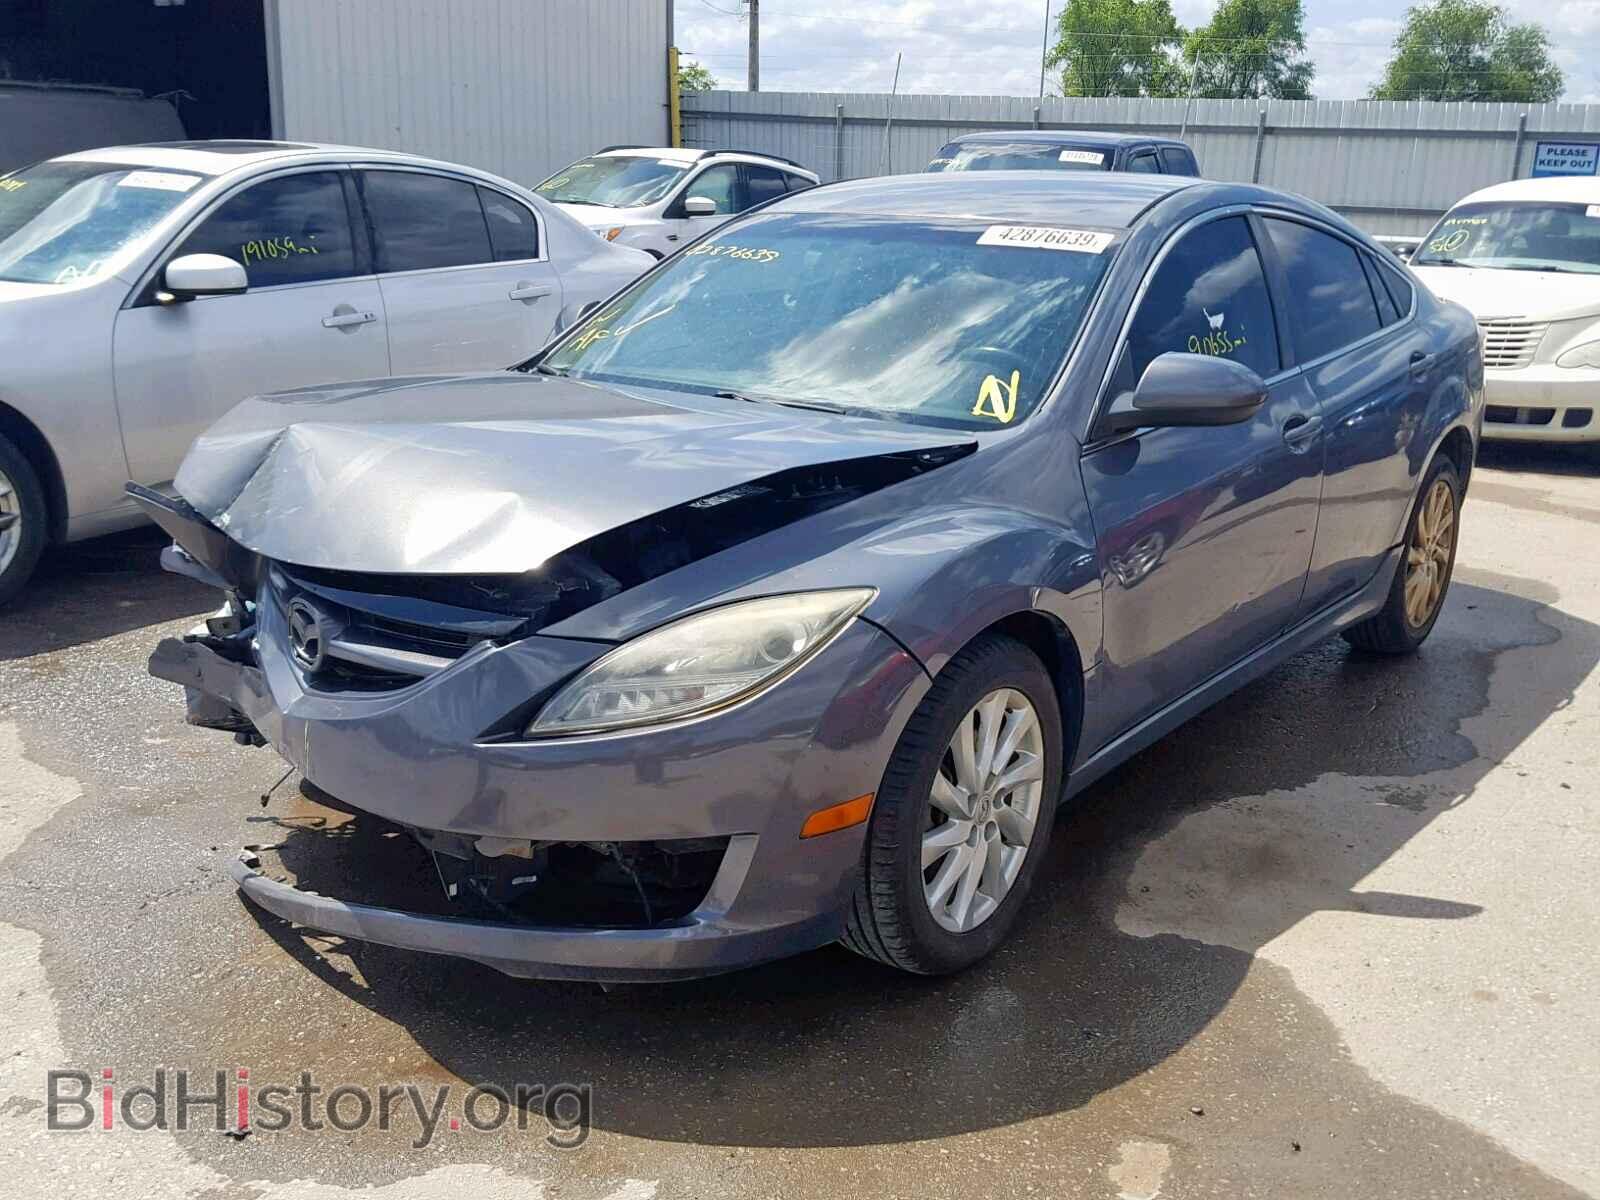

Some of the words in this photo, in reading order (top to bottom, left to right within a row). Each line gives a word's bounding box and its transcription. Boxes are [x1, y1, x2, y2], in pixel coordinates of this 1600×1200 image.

[1546, 147, 1588, 157] PLEASE
[1538, 159, 1567, 168] KEEP
[1570, 160, 1593, 168] OUT
[999, 227, 1096, 246] 42876639
